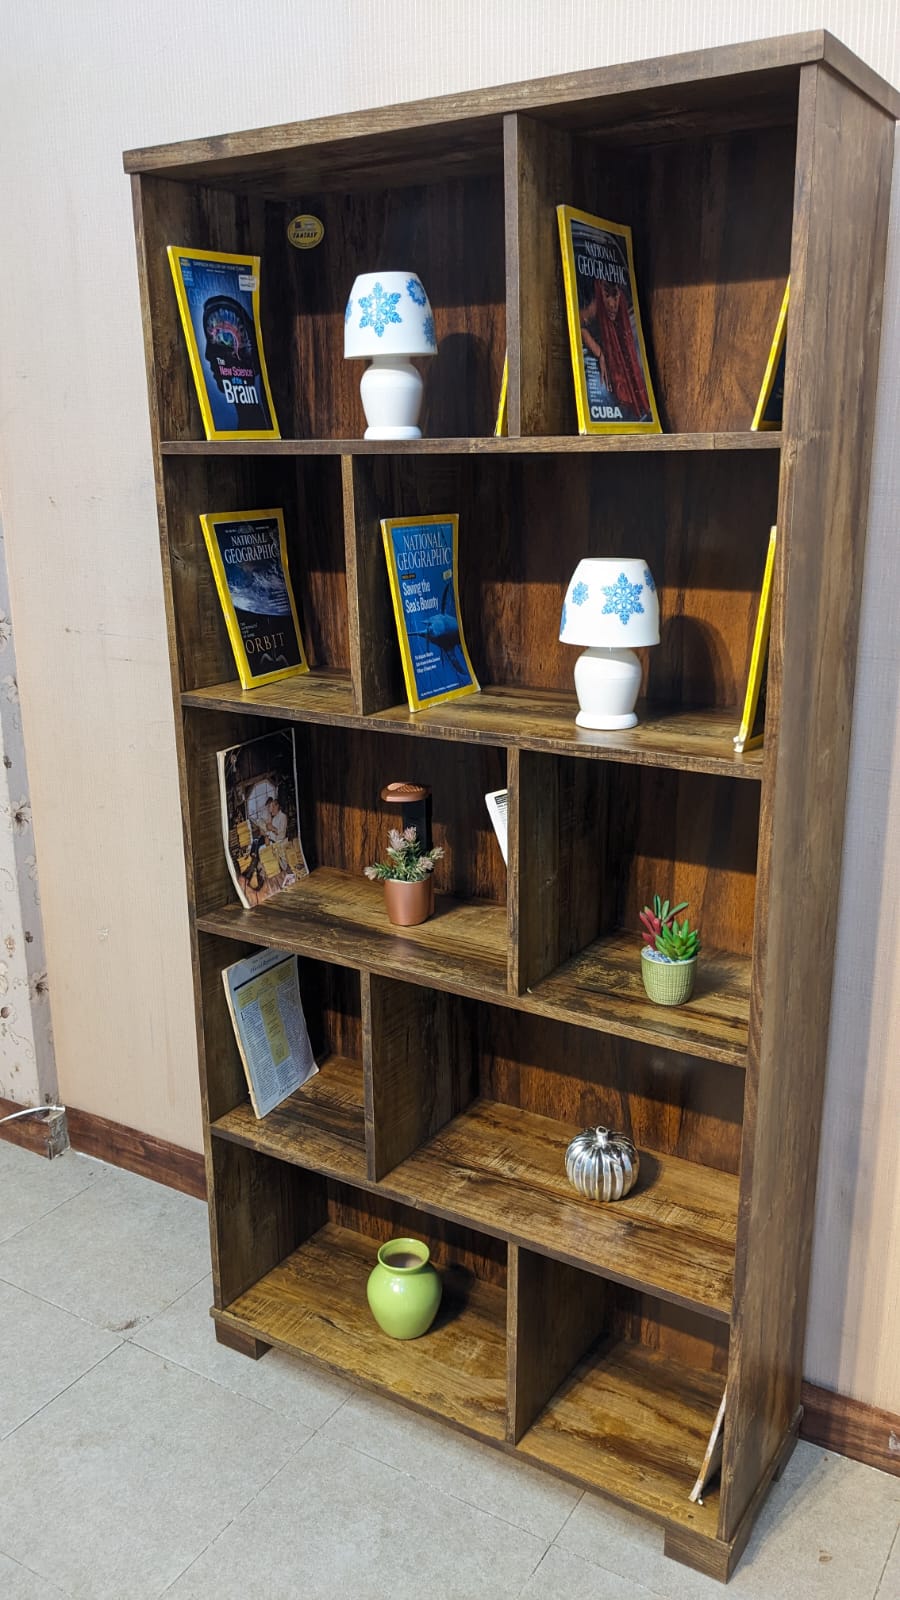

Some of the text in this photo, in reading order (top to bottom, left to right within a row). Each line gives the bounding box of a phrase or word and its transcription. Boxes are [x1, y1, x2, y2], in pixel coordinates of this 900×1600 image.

[584, 240, 617, 262] NATIONAL
[577, 254, 627, 285] GEOGRAPHIC
[216, 357, 225, 365] The
[219, 366, 253, 377] New Science
[222, 379, 258, 404] Brain
[590, 405, 623, 419] CUBA
[231, 532, 267, 546] NATIONAL
[403, 531, 443, 551] NATIONAL
[224, 543, 277, 565] GEOGRAPHIC
[397, 547, 451, 571] GEOGRAPHIC
[402, 579, 431, 596] Saving the
[405, 596, 439, 613] Sea's Bounty
[245, 632, 285, 654] ORBIT
